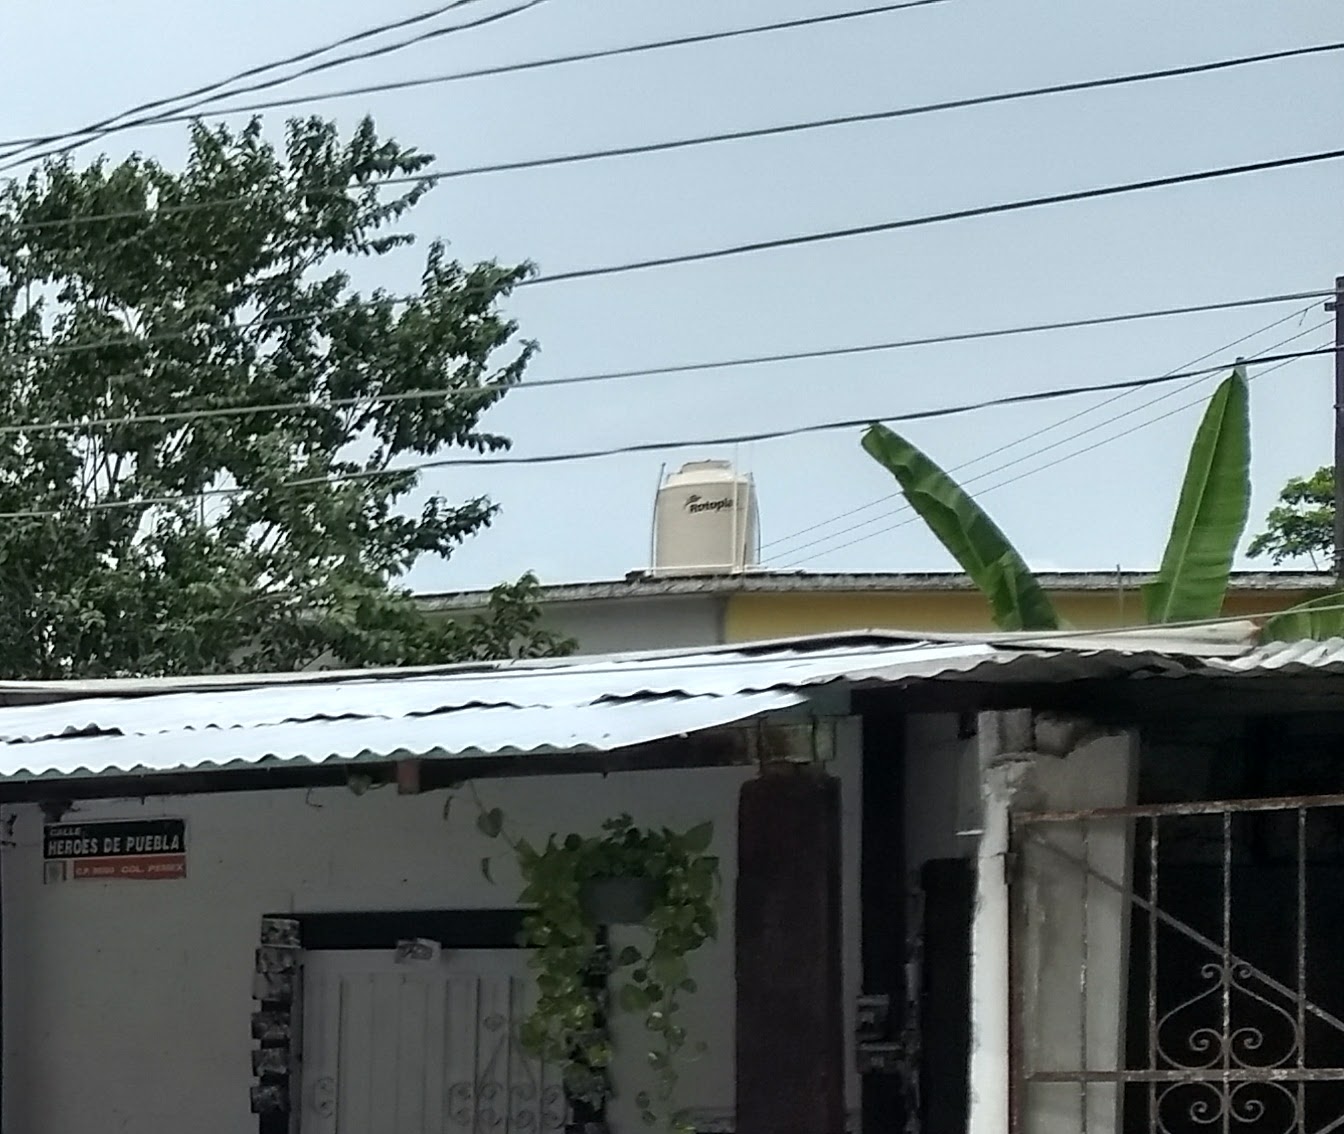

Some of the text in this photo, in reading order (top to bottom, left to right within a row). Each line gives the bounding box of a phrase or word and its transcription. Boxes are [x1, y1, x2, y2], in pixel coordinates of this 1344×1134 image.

[689, 498, 736, 513] Rotopla
[49, 827, 81, 836] CALLE
[47, 834, 180, 856] HEROES DE PUEBLA
